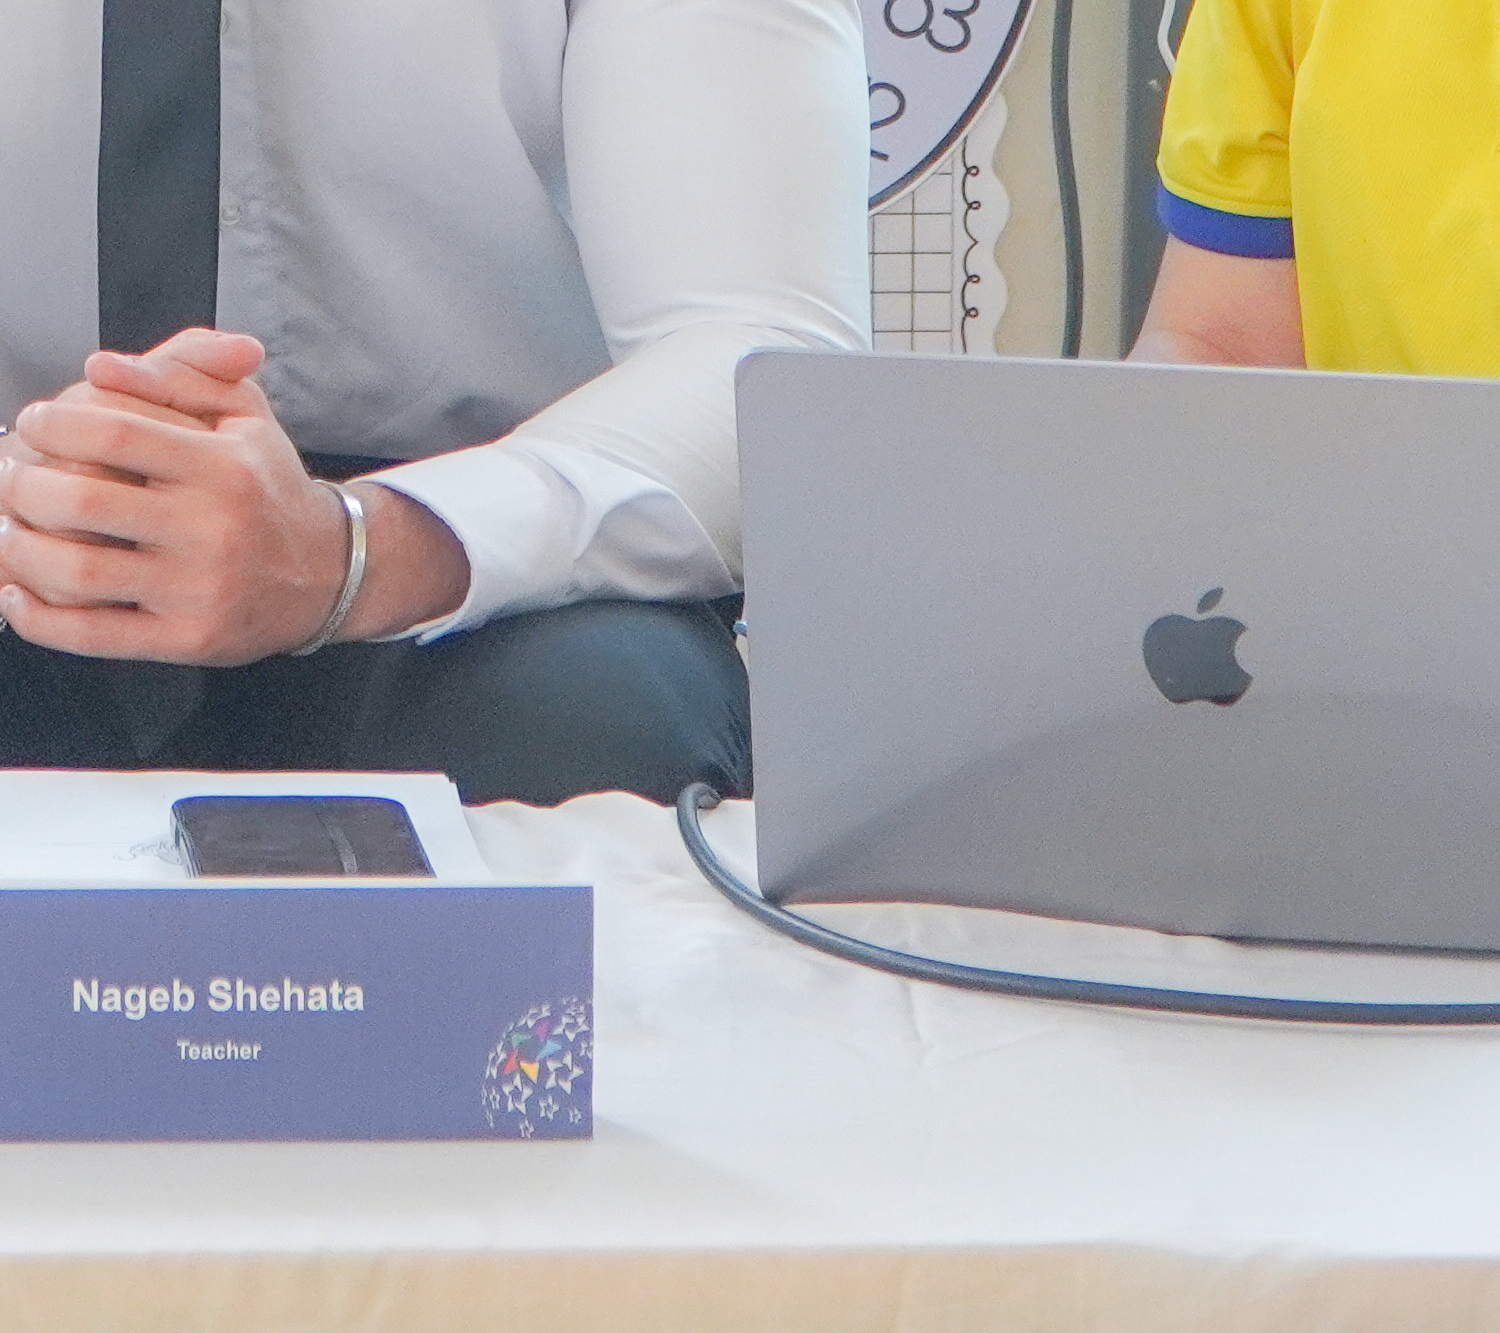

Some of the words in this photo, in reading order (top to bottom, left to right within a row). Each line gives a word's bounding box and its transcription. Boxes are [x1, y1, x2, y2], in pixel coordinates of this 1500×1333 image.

[71, 978, 196, 1020] Nageb
[209, 976, 366, 1013] Shehata
[176, 1038, 262, 1062] Teacher
